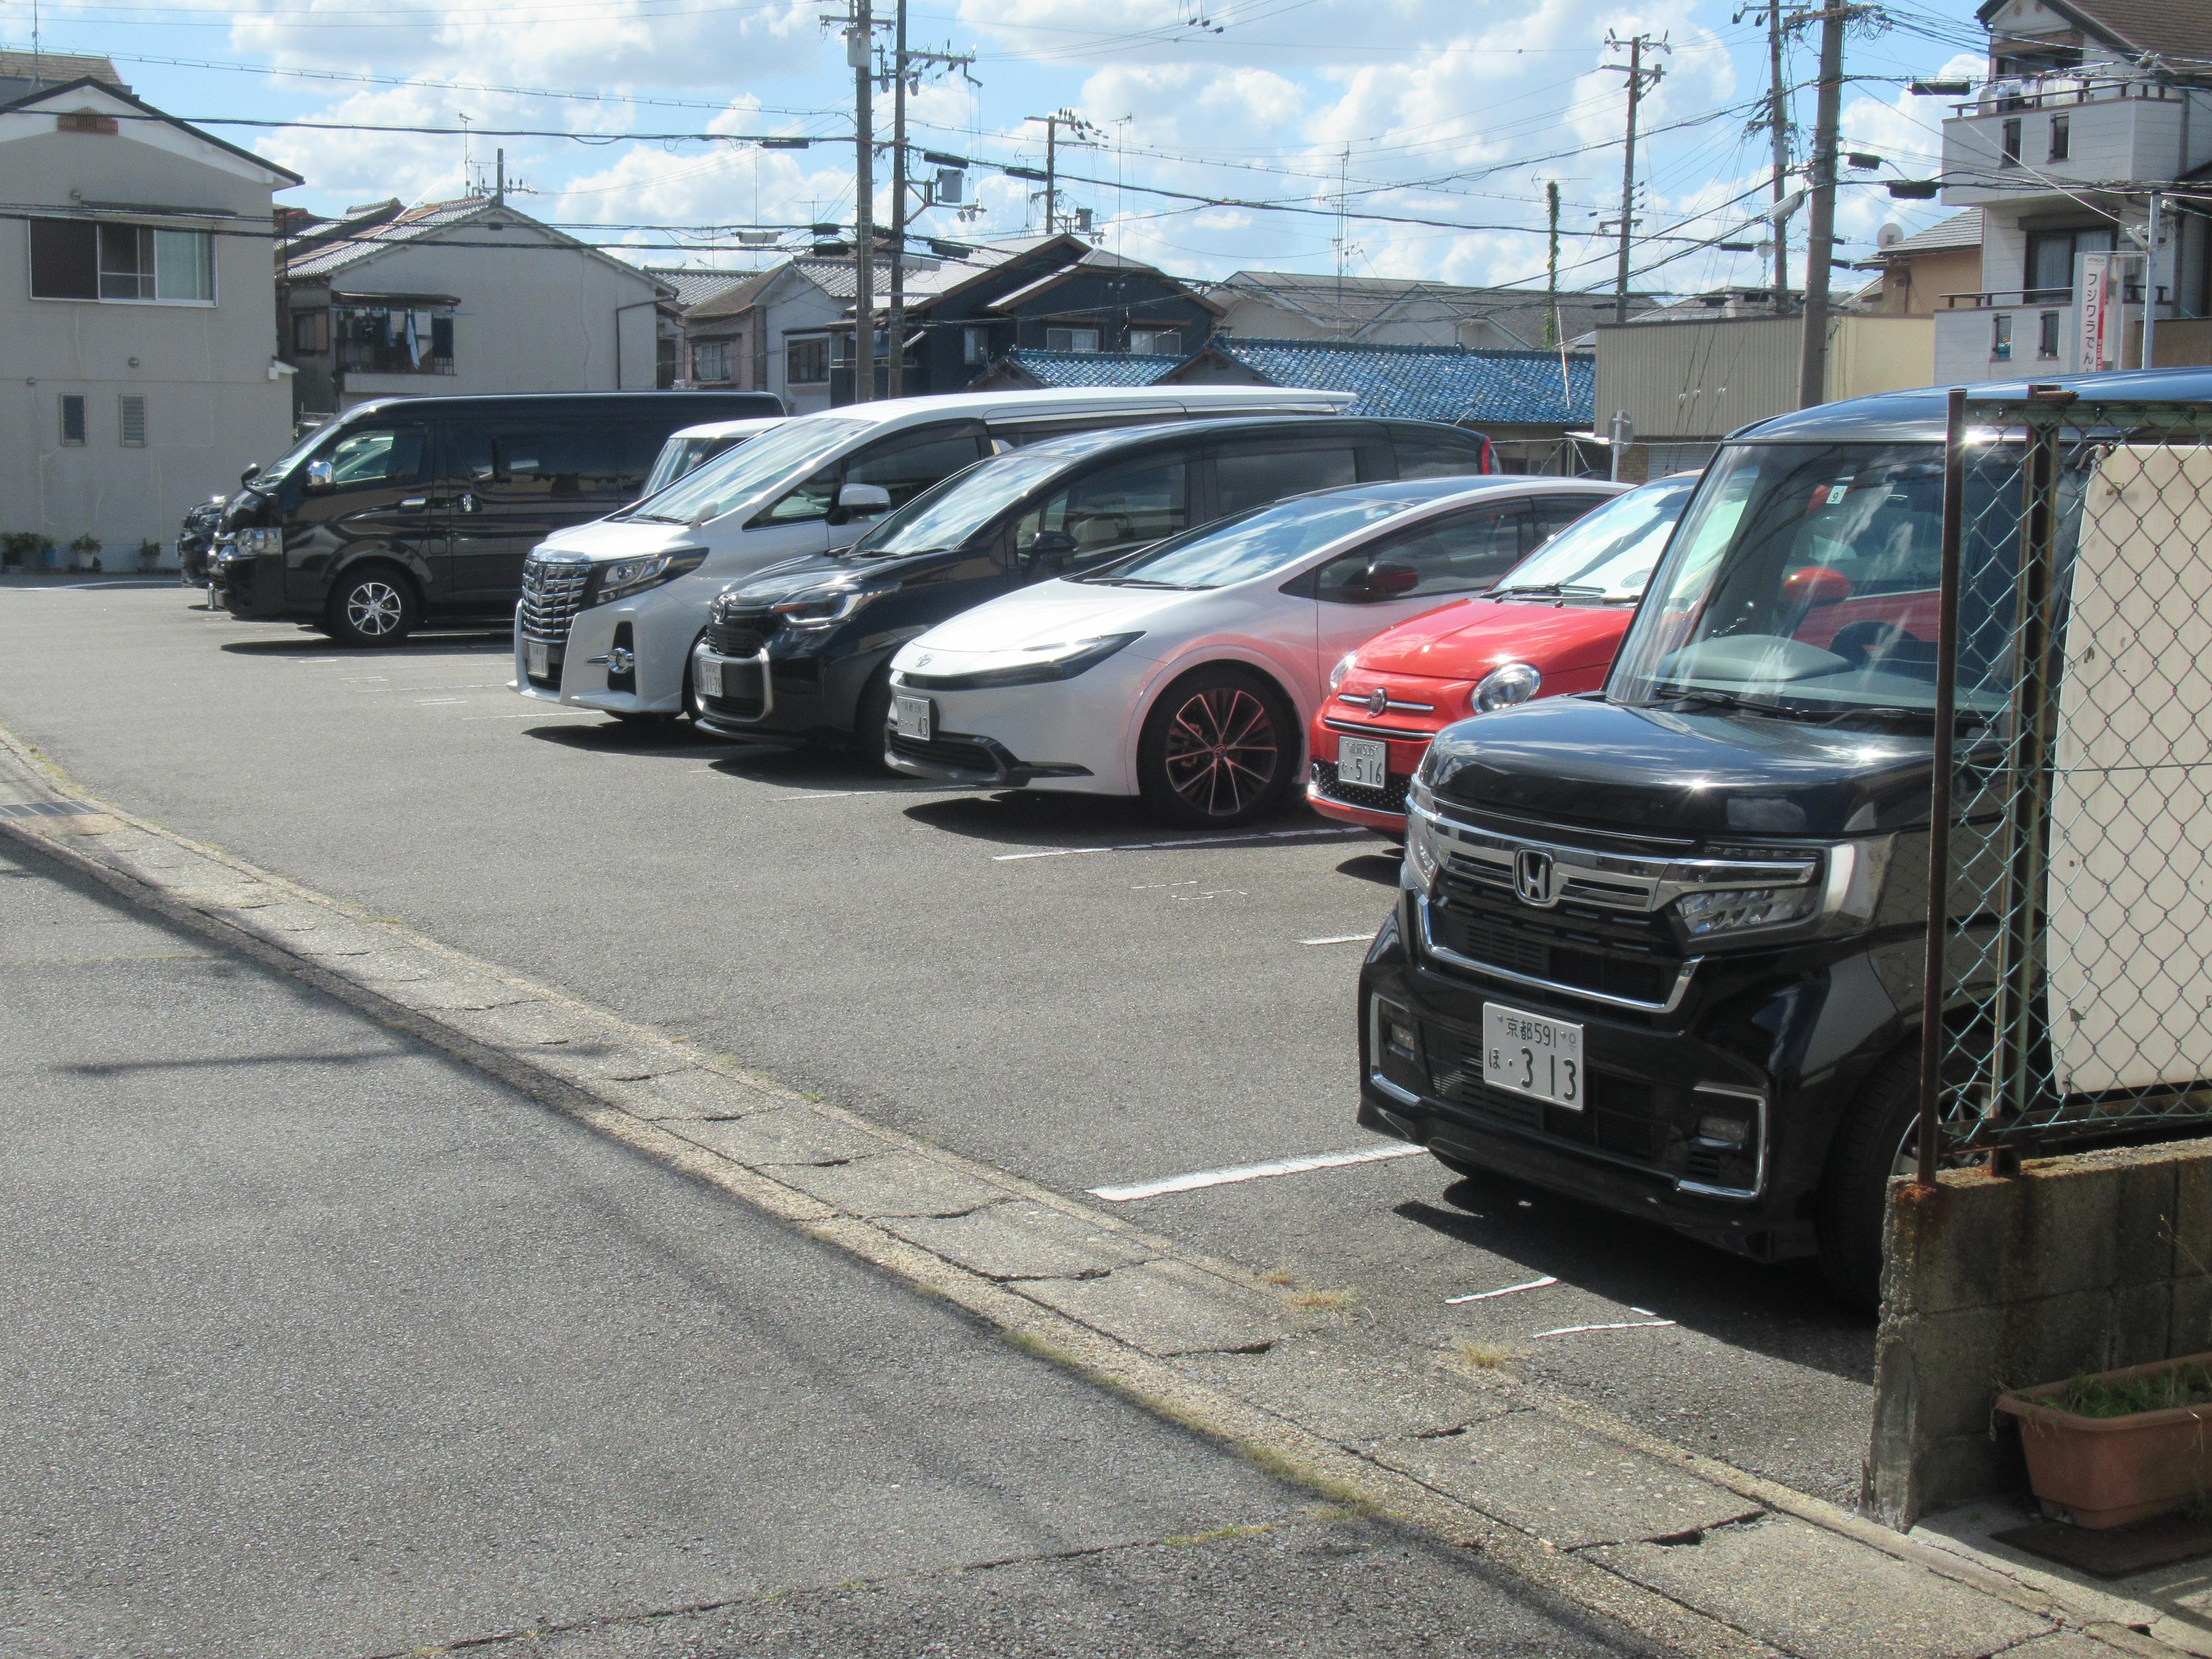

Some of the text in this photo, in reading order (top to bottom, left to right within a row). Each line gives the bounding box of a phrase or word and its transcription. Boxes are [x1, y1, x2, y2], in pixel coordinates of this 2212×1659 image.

[2084, 273, 2097, 372] フジワラでん
[1506, 1017, 1556, 1048] 京都591
[1488, 1048, 1501, 1070] ほ
